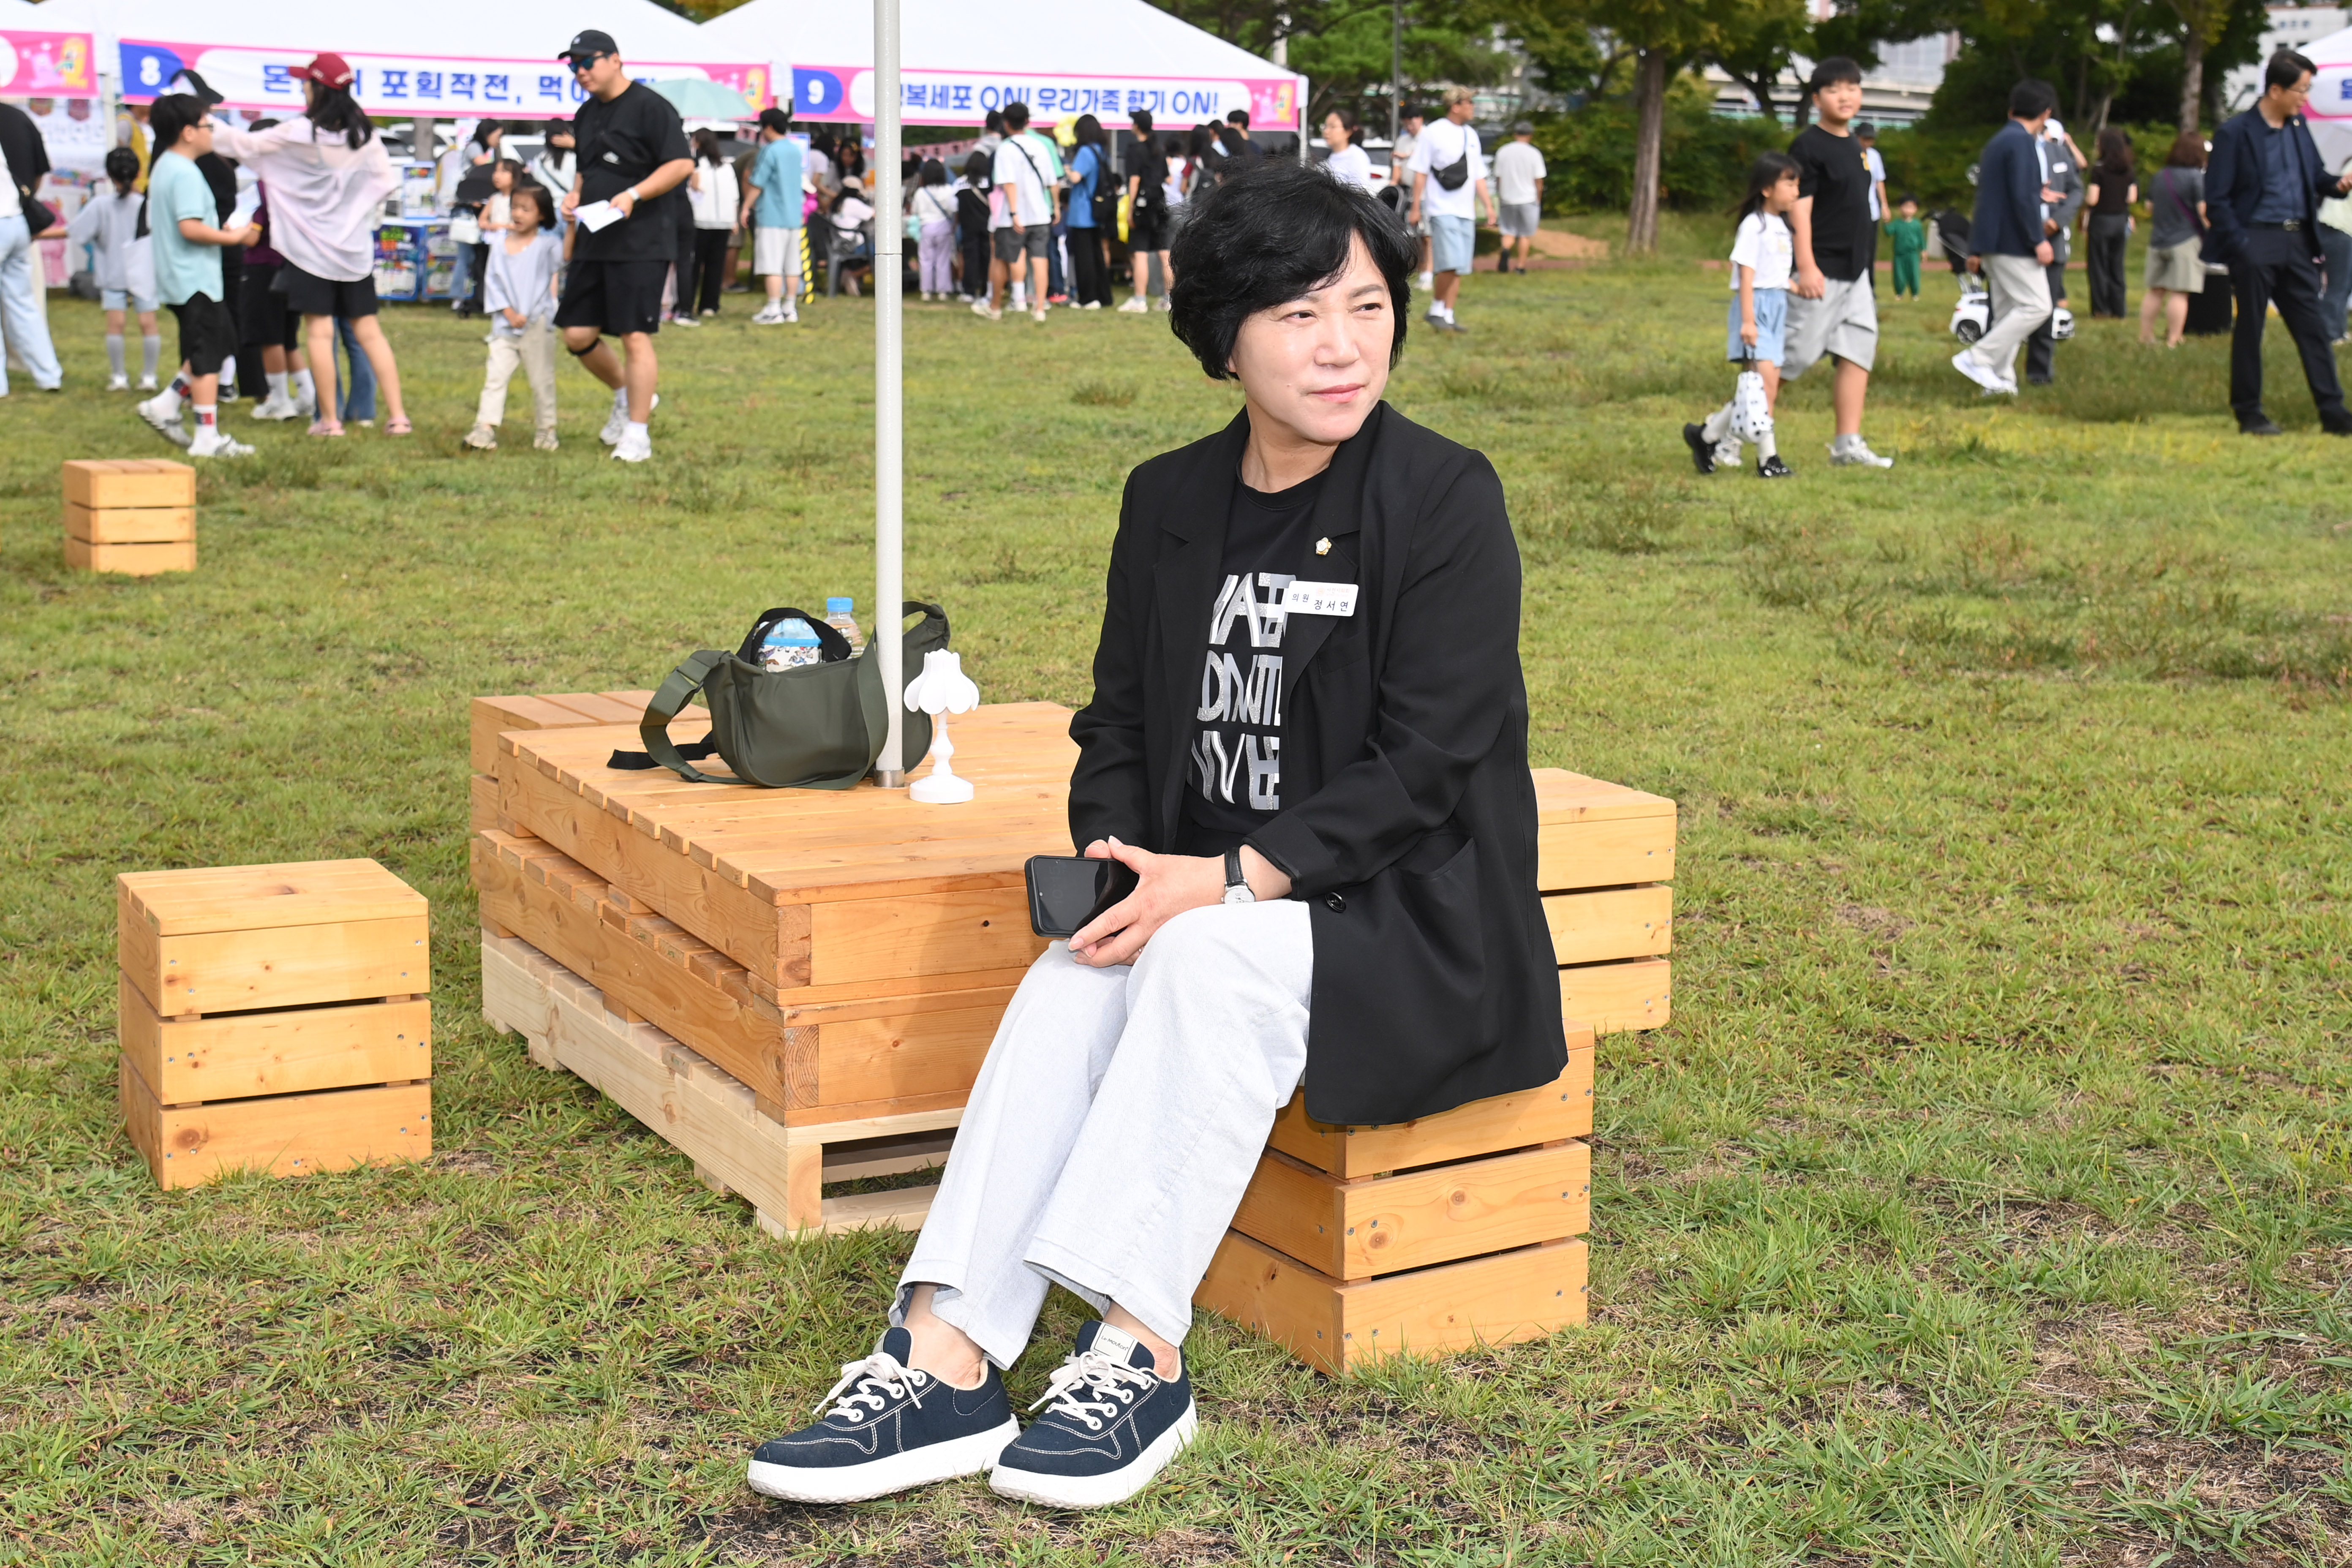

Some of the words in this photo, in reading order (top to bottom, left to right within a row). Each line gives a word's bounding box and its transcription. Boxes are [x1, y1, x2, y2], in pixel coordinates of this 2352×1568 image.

[139, 56, 161, 86] 8
[382, 71, 520, 104] 포획작전,
[807, 79, 825, 105] 9
[901, 84, 971, 110] 복세포
[1038, 88, 1119, 113] 우리가족
[1173, 91, 1217, 114] ON!
[1292, 593, 1309, 602] 의원
[1314, 600, 1348, 612] 정서연
